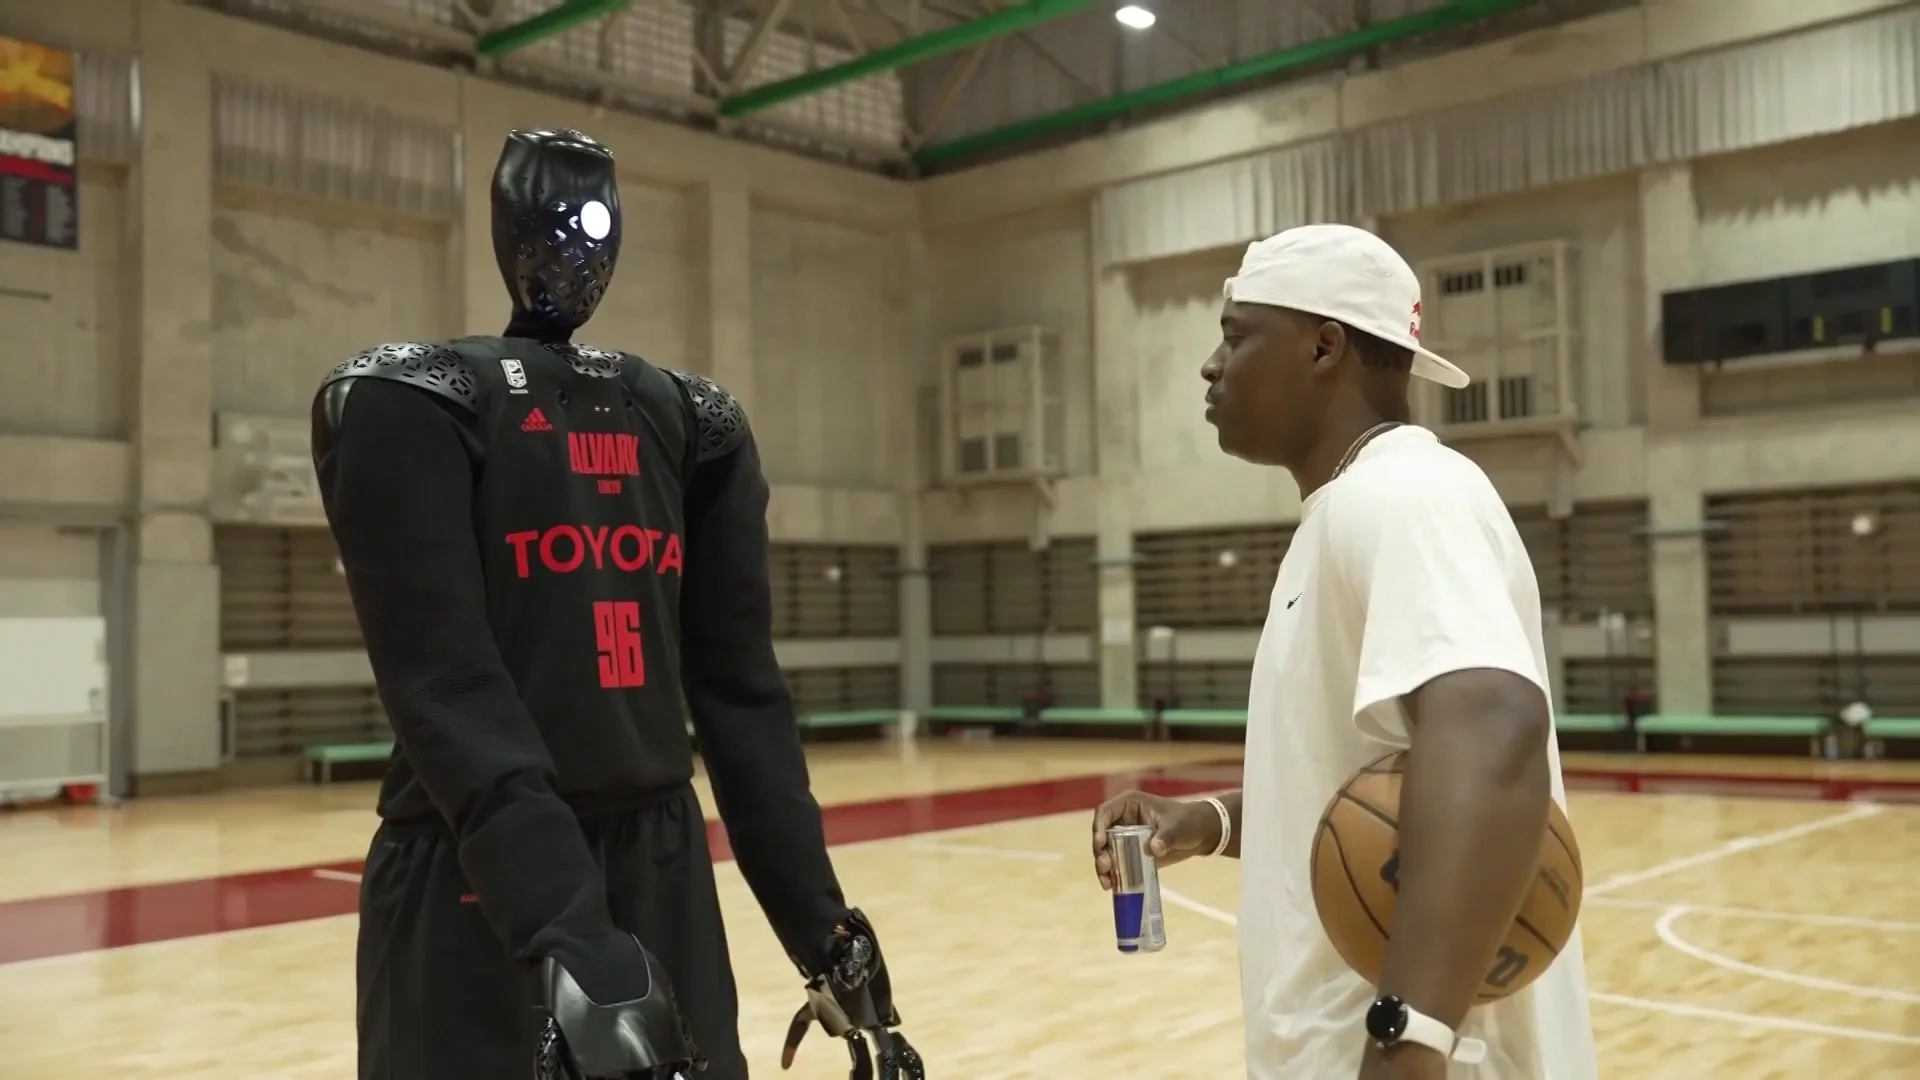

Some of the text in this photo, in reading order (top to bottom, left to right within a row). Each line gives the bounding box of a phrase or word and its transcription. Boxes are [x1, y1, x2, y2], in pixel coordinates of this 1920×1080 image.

[567, 431, 640, 476] ALVARK
[505, 524, 683, 578] TOYOTA
[593, 600, 646, 689] 96
